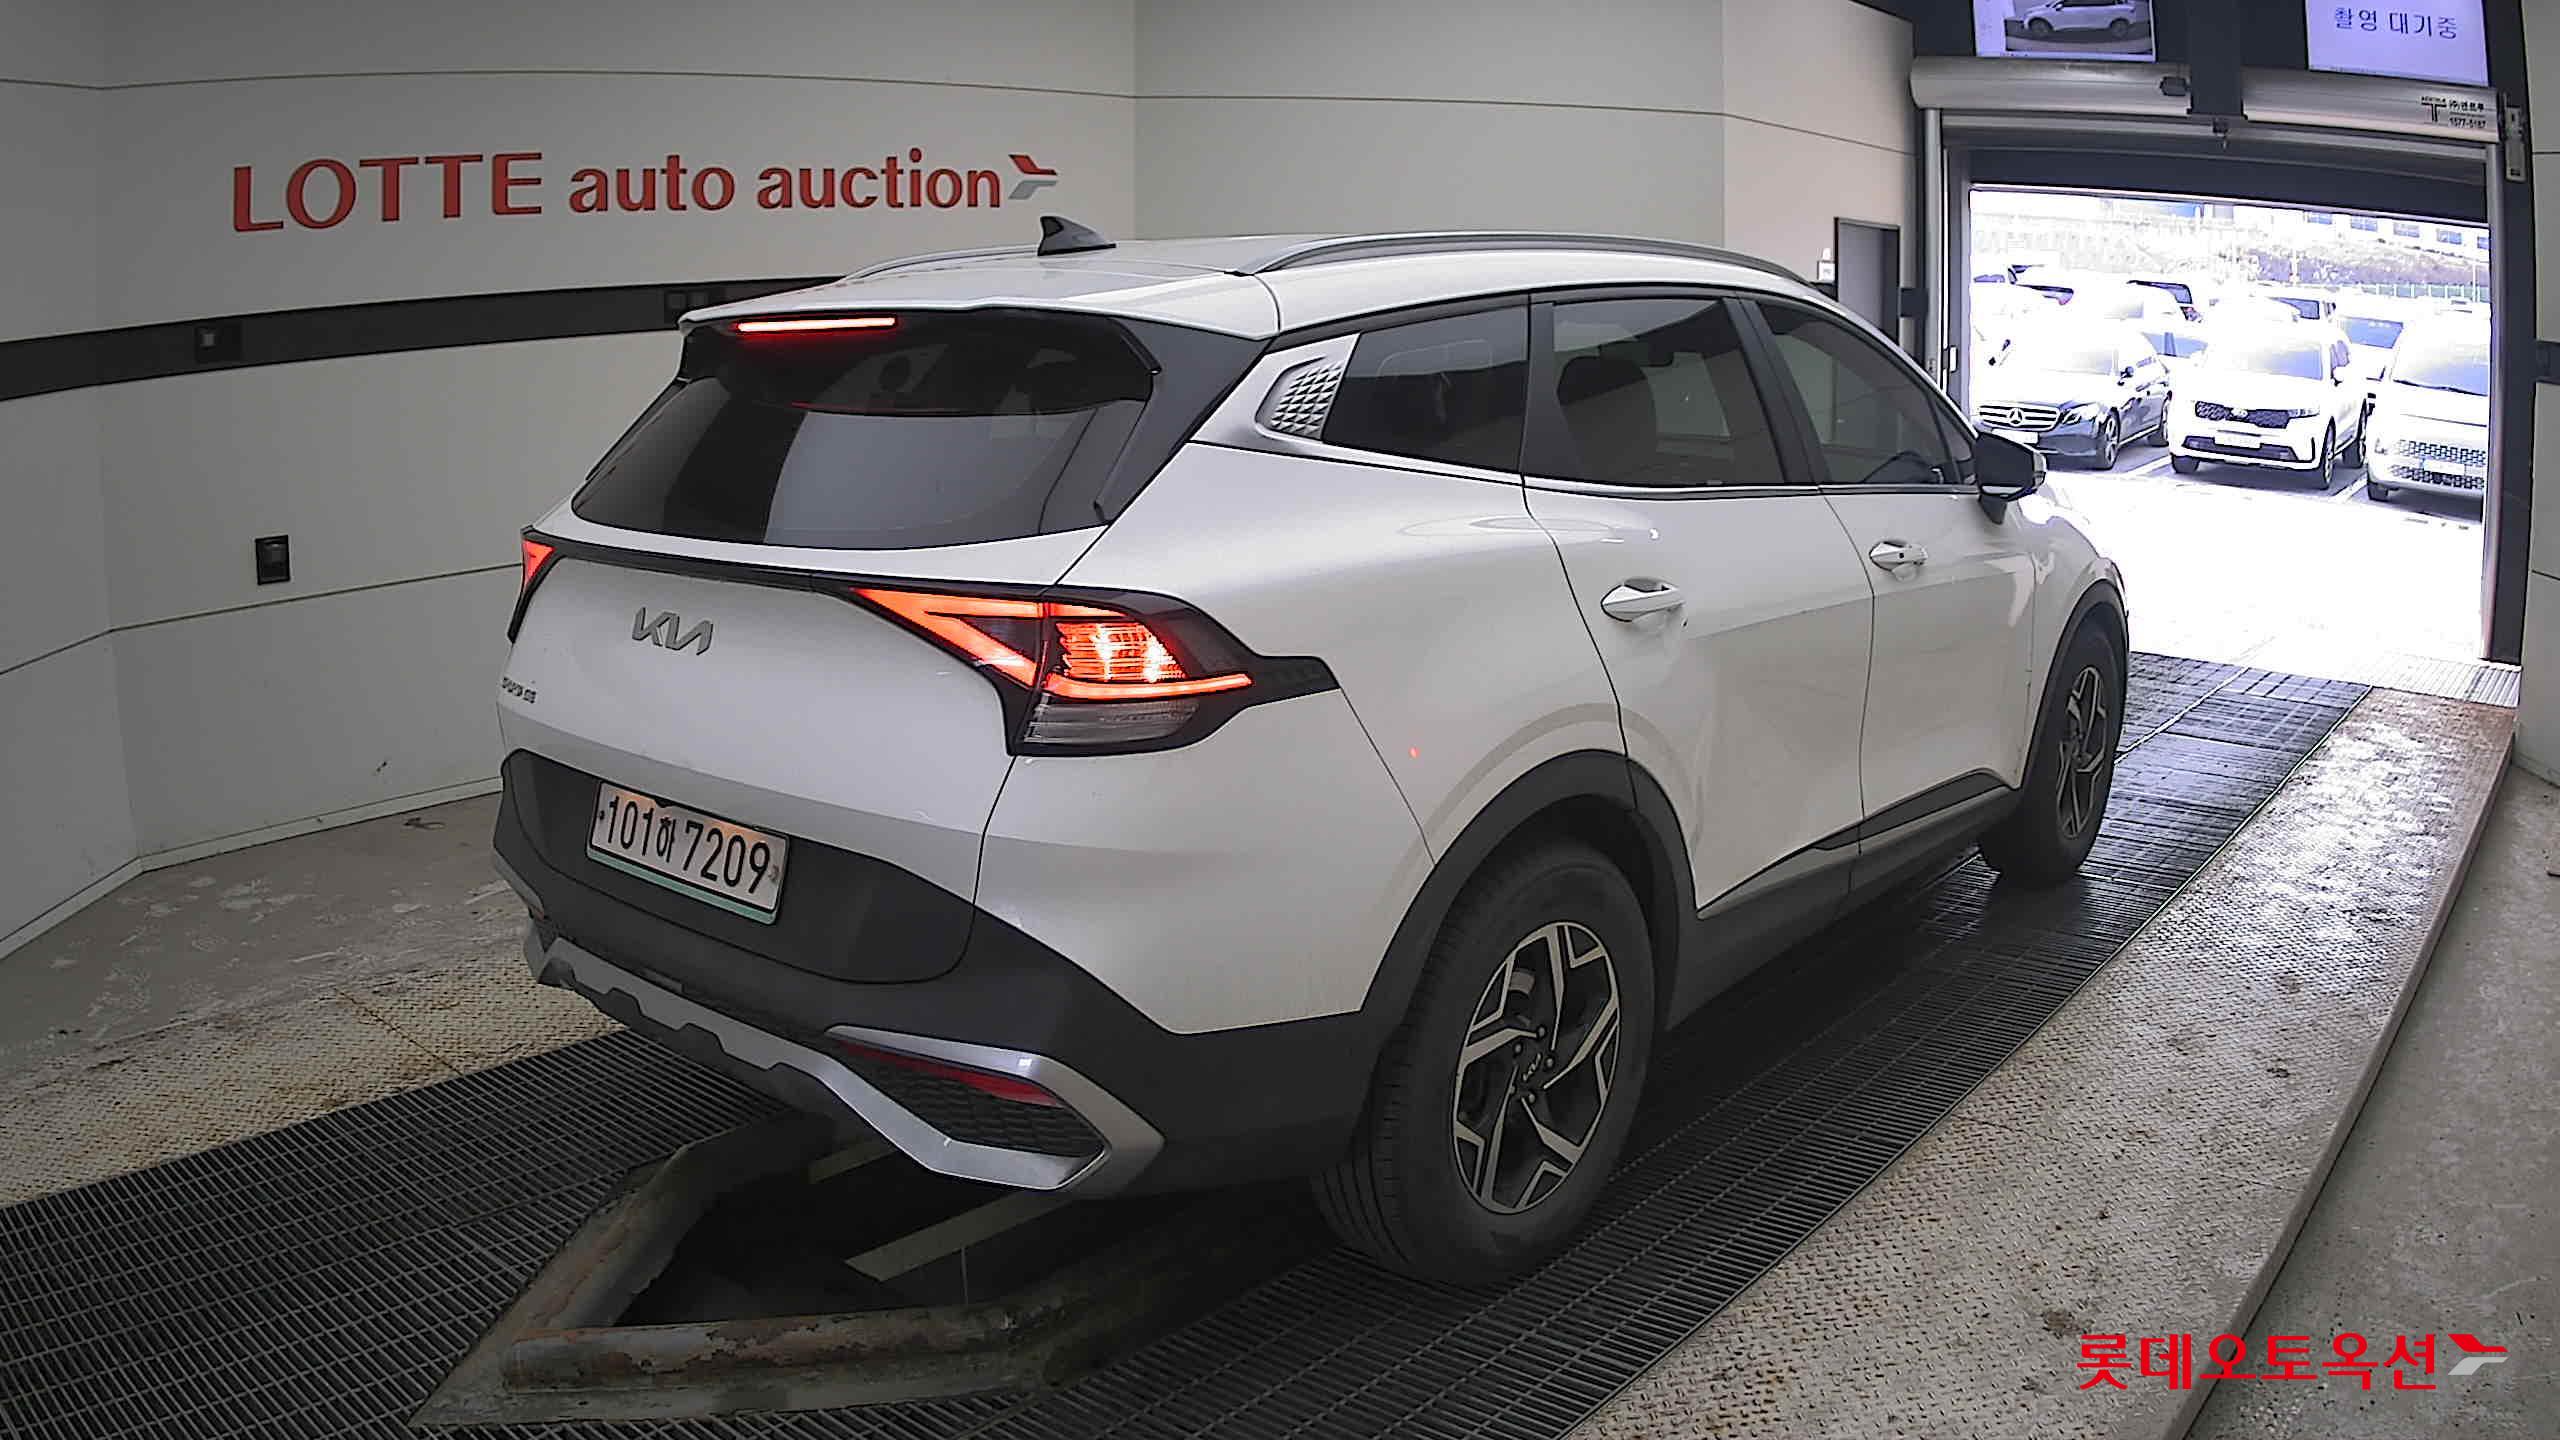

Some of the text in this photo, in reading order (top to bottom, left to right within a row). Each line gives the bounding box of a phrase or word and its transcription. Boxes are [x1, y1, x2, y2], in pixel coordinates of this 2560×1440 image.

[2389, 12, 2458, 40] 대기중
[233, 147, 1001, 232] LOTTE auto auction
[683, 820, 771, 895] 7209
